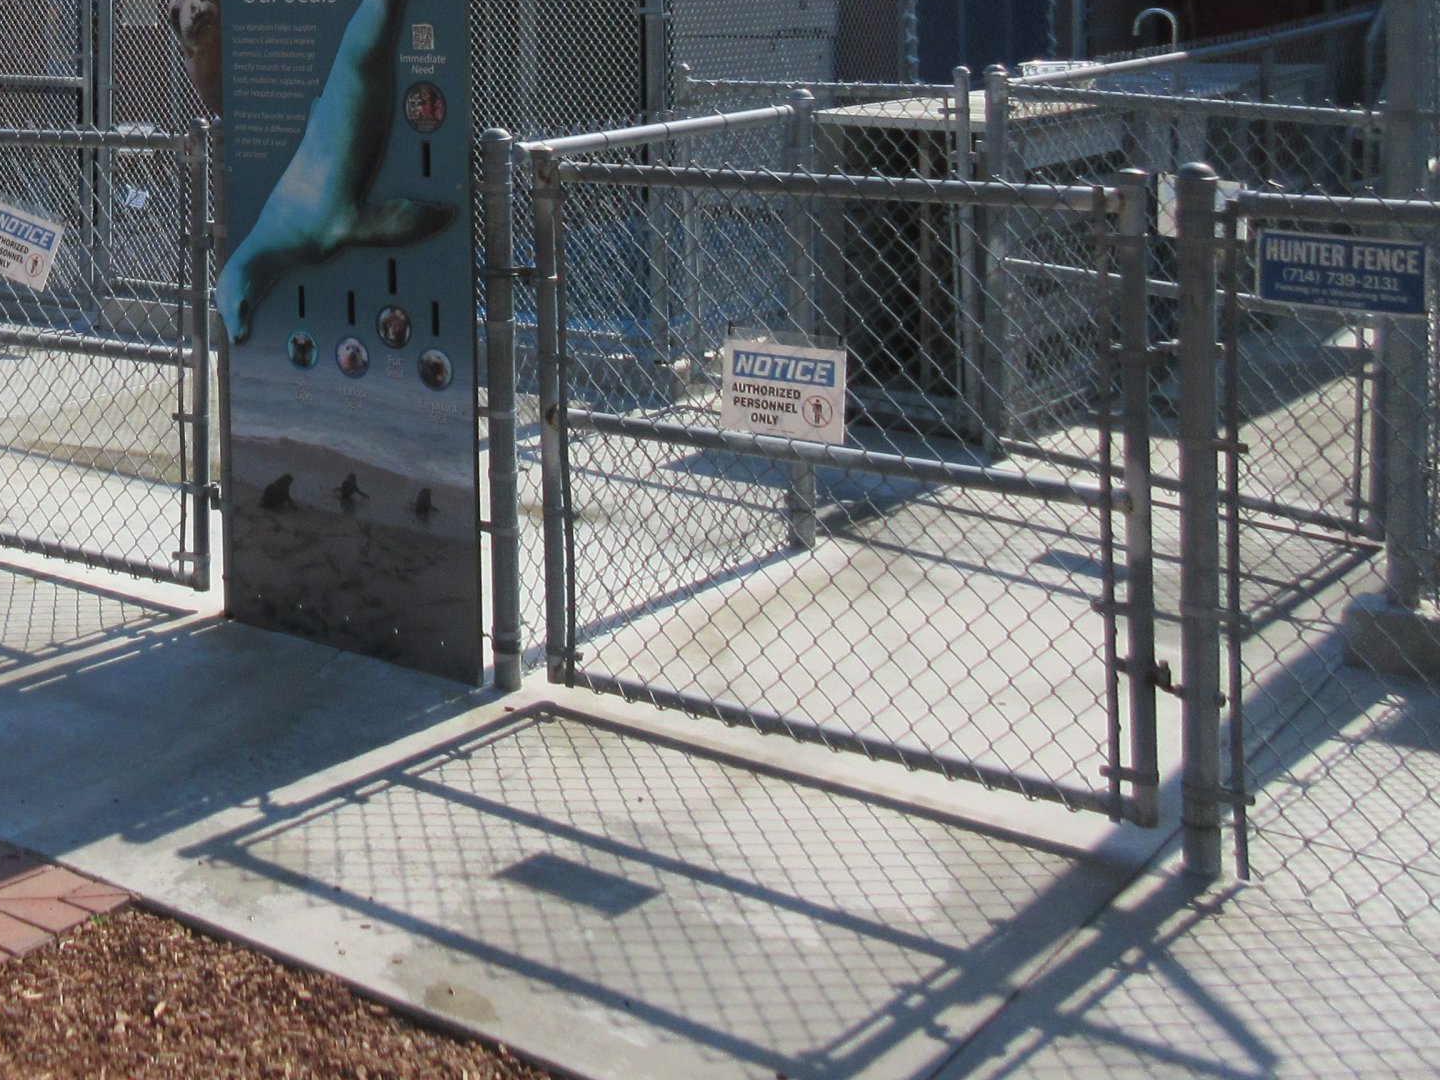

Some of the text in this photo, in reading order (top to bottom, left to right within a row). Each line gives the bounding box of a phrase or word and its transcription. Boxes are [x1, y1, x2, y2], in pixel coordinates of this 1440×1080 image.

[400, 54, 446, 64] Immediate
[412, 65, 435, 75] Need
[1265, 237, 1419, 275] HUNTER FENCE
[1282, 267, 1400, 291] (714) 739-2131
[387, 354, 402, 366] Fur
[385, 366, 405, 378] Seal
[735, 353, 832, 384] NOTICE
[732, 382, 801, 400] AUTHORIZED
[420, 399, 458, 415] Elephant
[733, 396, 798, 414] PERSONNEL
[750, 412, 779, 425] ONLY
